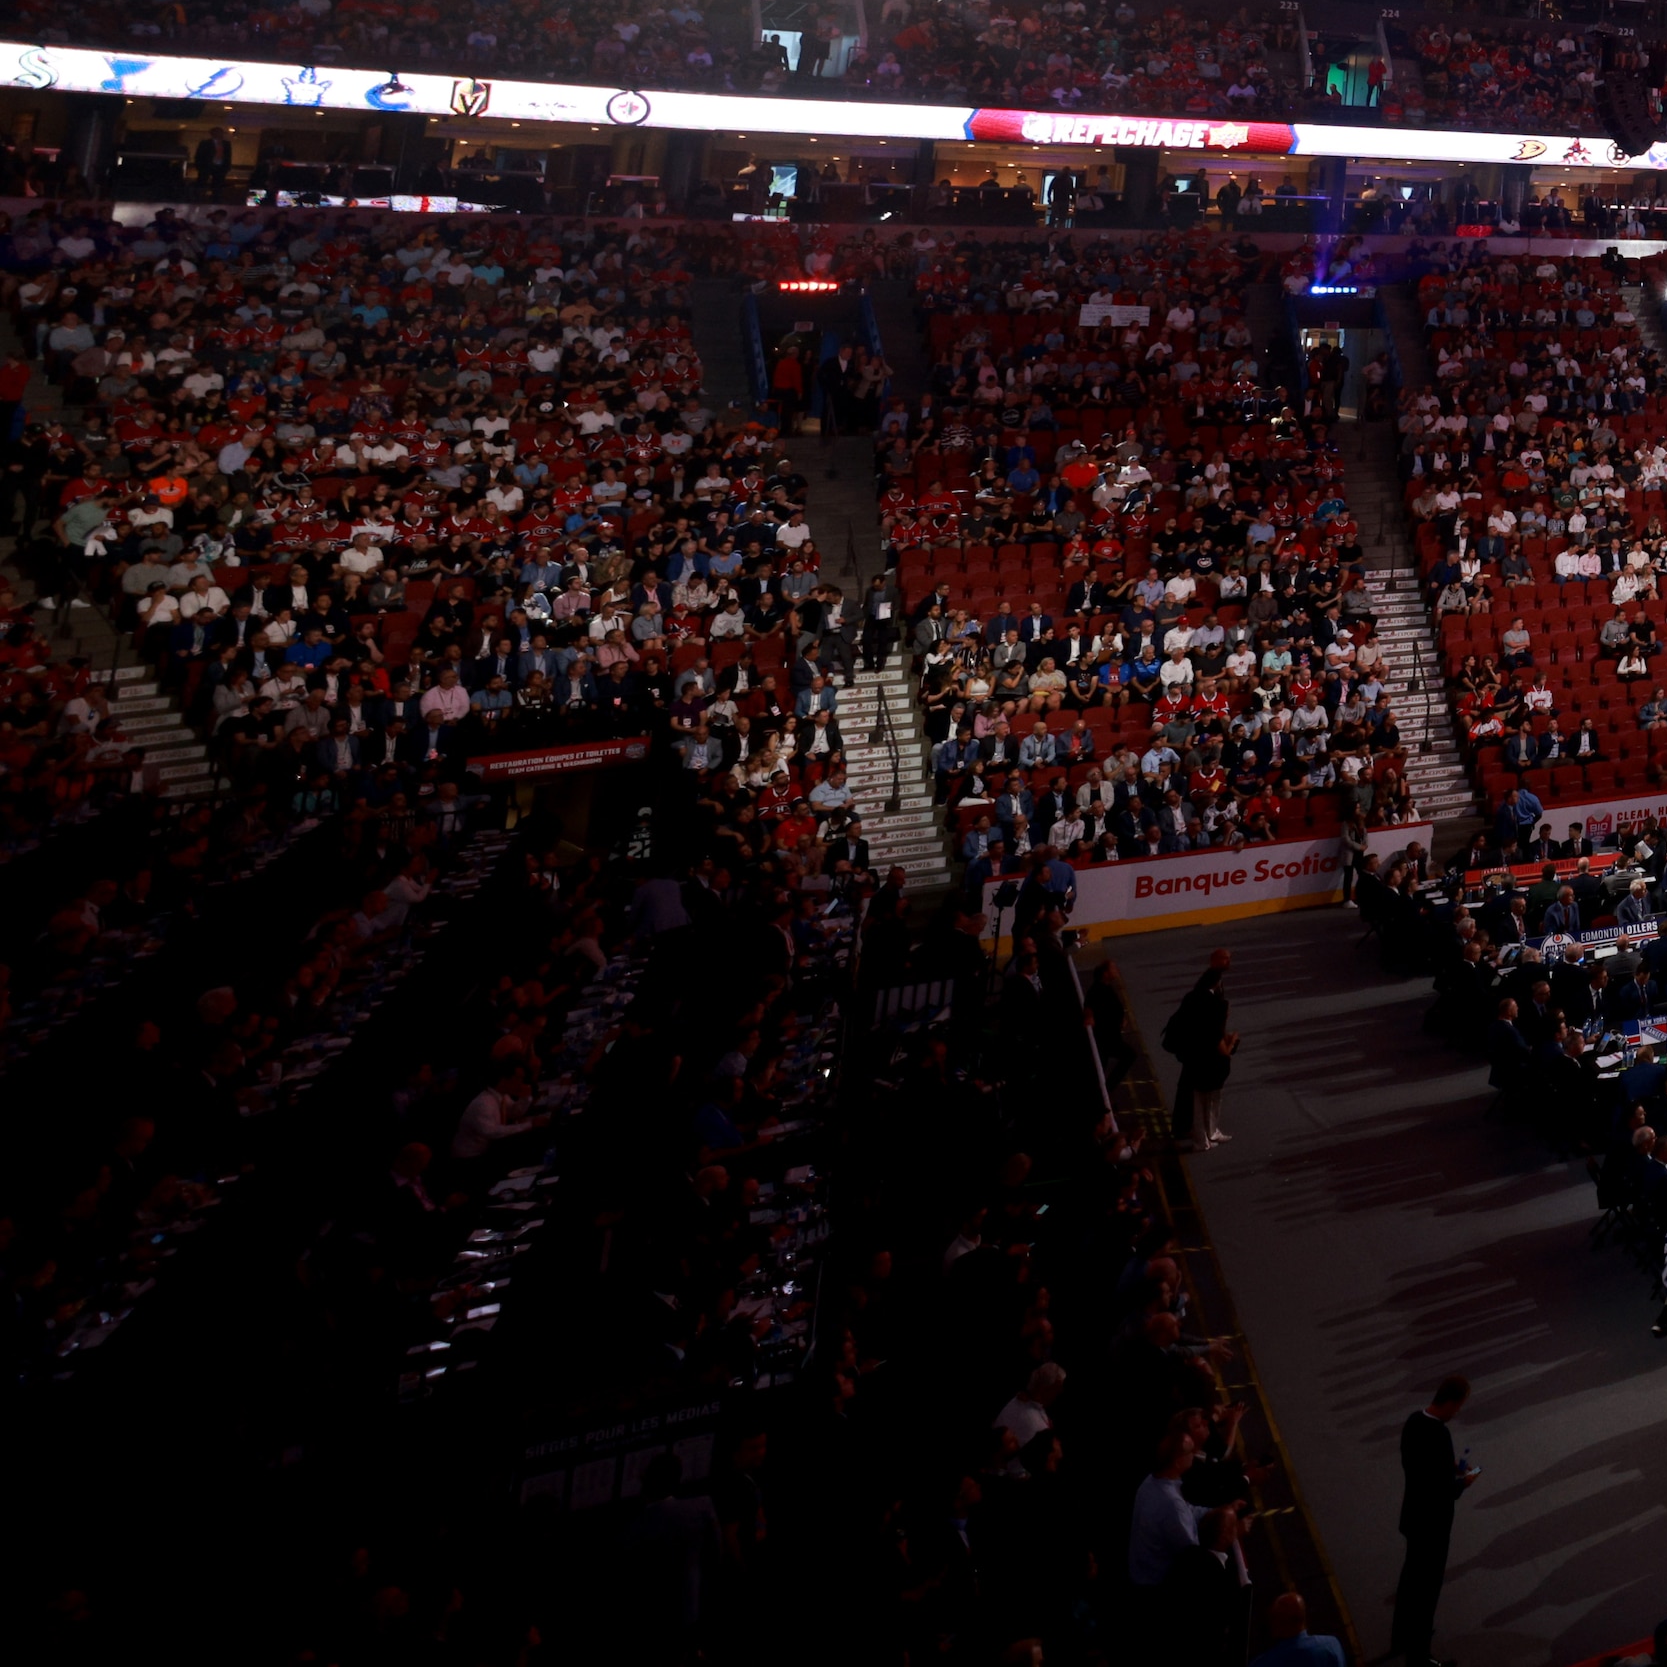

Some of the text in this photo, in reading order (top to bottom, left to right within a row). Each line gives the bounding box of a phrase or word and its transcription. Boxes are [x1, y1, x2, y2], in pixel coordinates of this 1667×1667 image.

[1279, 0, 1300, 11] 223
[1381, 8, 1401, 19] 224
[1134, 853, 1338, 900] Banque Scotia
[1580, 921, 1659, 944] EDMONTON OILERS
[525, 1433, 579, 1459] SIÈGES
[585, 1422, 625, 1445] POUR
[629, 1413, 660, 1434] LES
[665, 1399, 723, 1428] MÉDIAS
